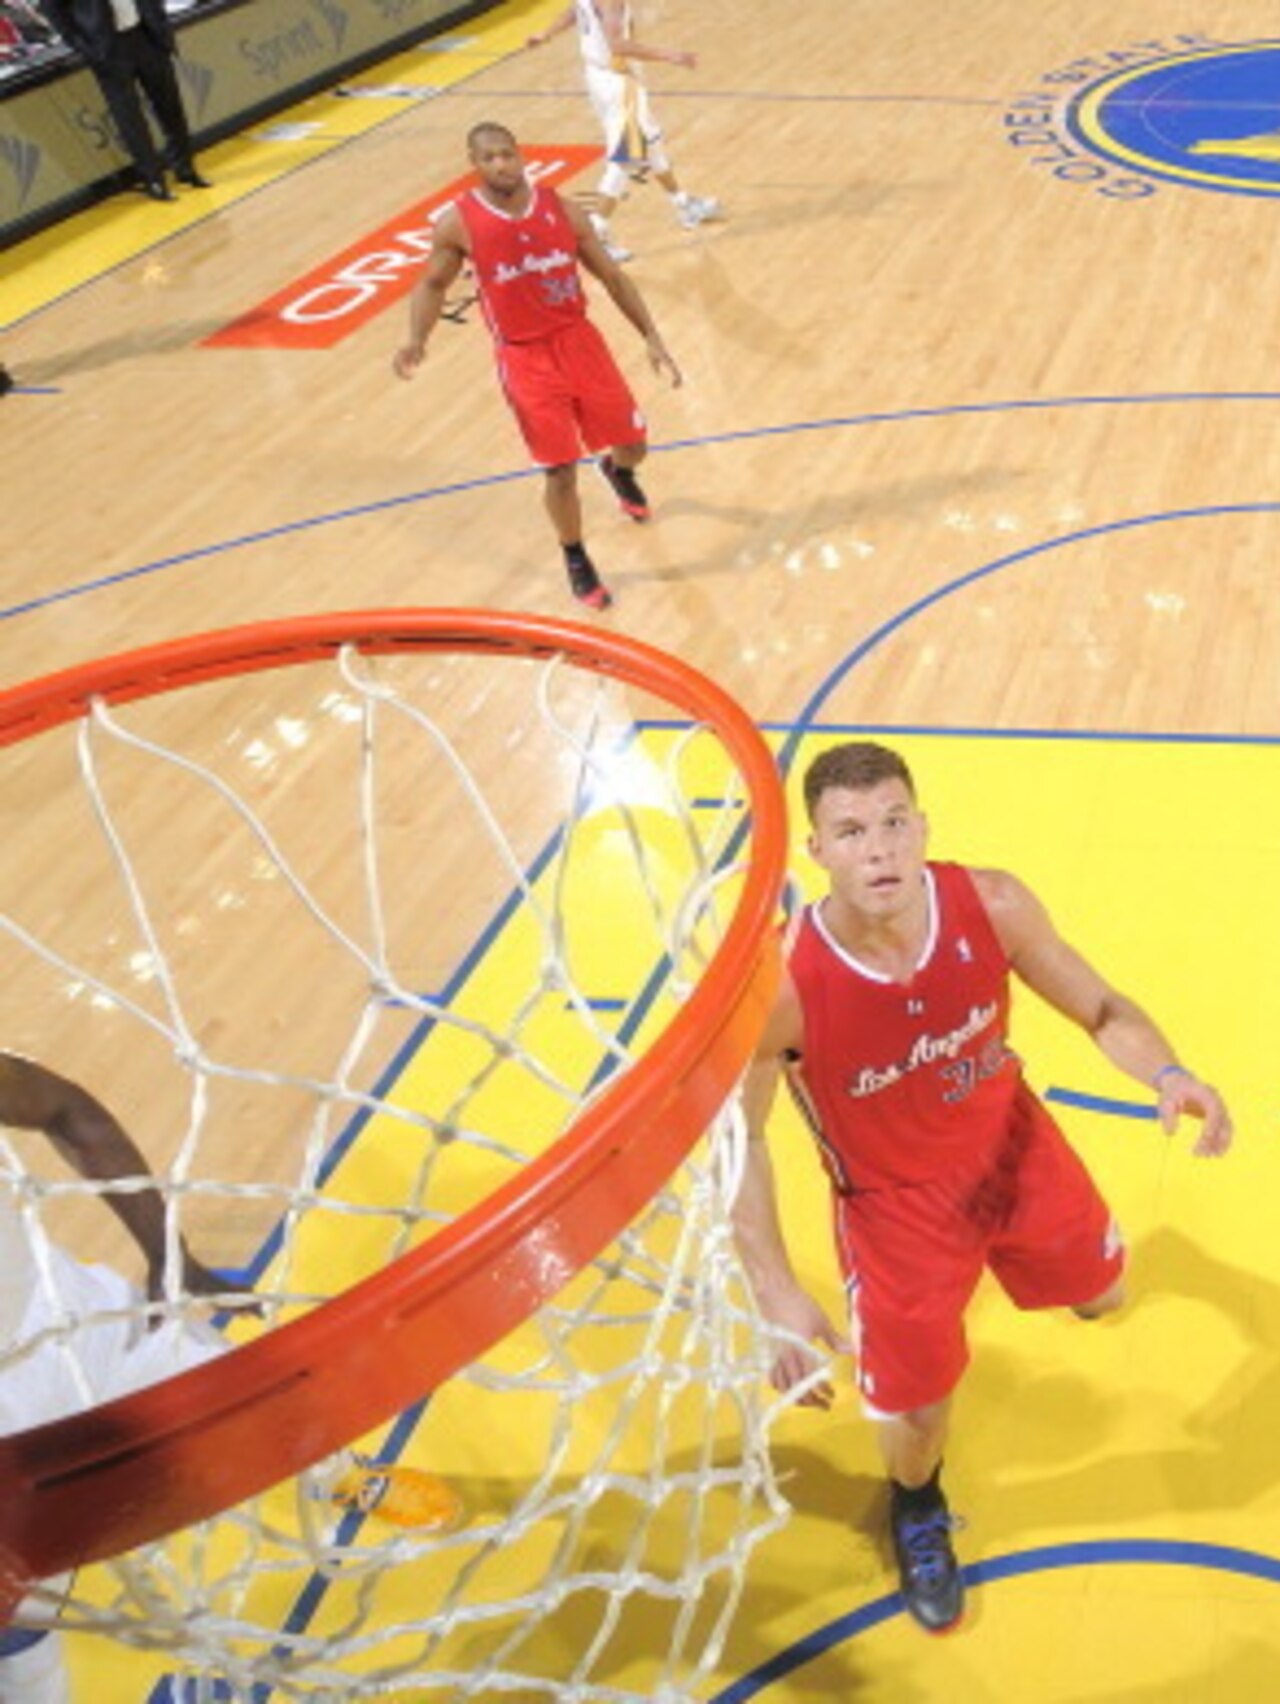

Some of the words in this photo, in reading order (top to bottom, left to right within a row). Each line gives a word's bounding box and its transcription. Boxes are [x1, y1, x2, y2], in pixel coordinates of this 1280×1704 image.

[1004, 92, 1156, 199] GOLDEN
[494, 262, 520, 284] Los
[521, 248, 570, 274] Angeles
[850, 1066, 902, 1098] Los
[906, 1001, 998, 1072] Angeles
